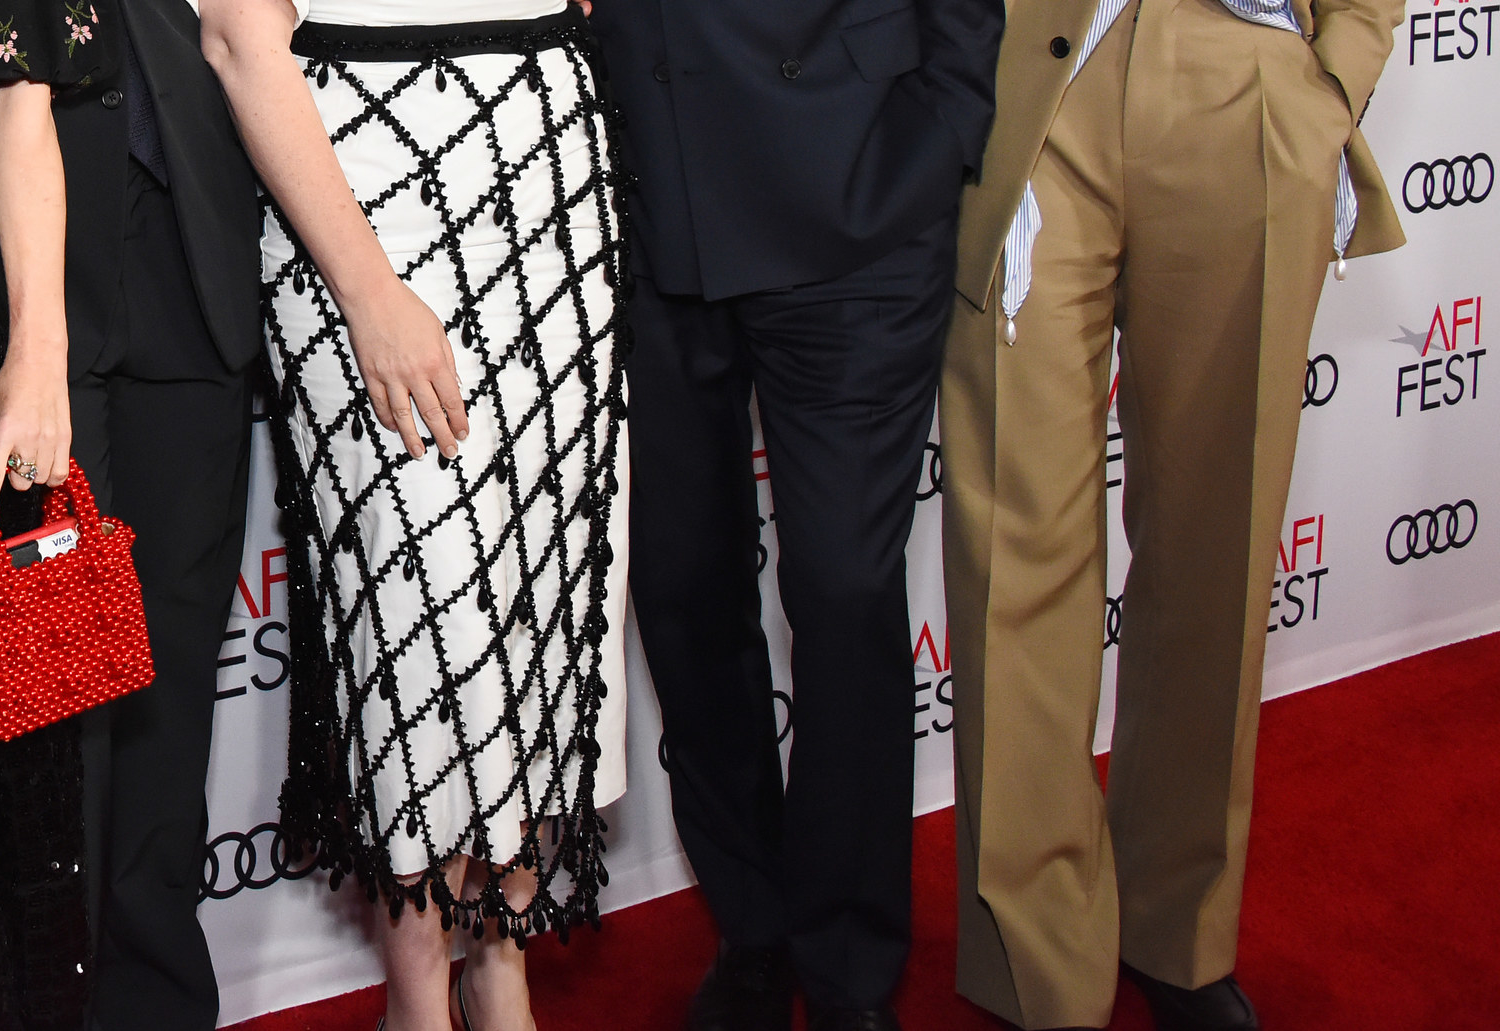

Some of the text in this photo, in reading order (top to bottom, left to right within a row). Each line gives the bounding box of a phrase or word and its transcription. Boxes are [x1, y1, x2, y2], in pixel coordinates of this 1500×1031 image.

[1410, 5, 1500, 66] FEST
[1421, 296, 1481, 357] AFI
[1396, 349, 1486, 417] FEST
[52, 534, 73, 547] VISA
